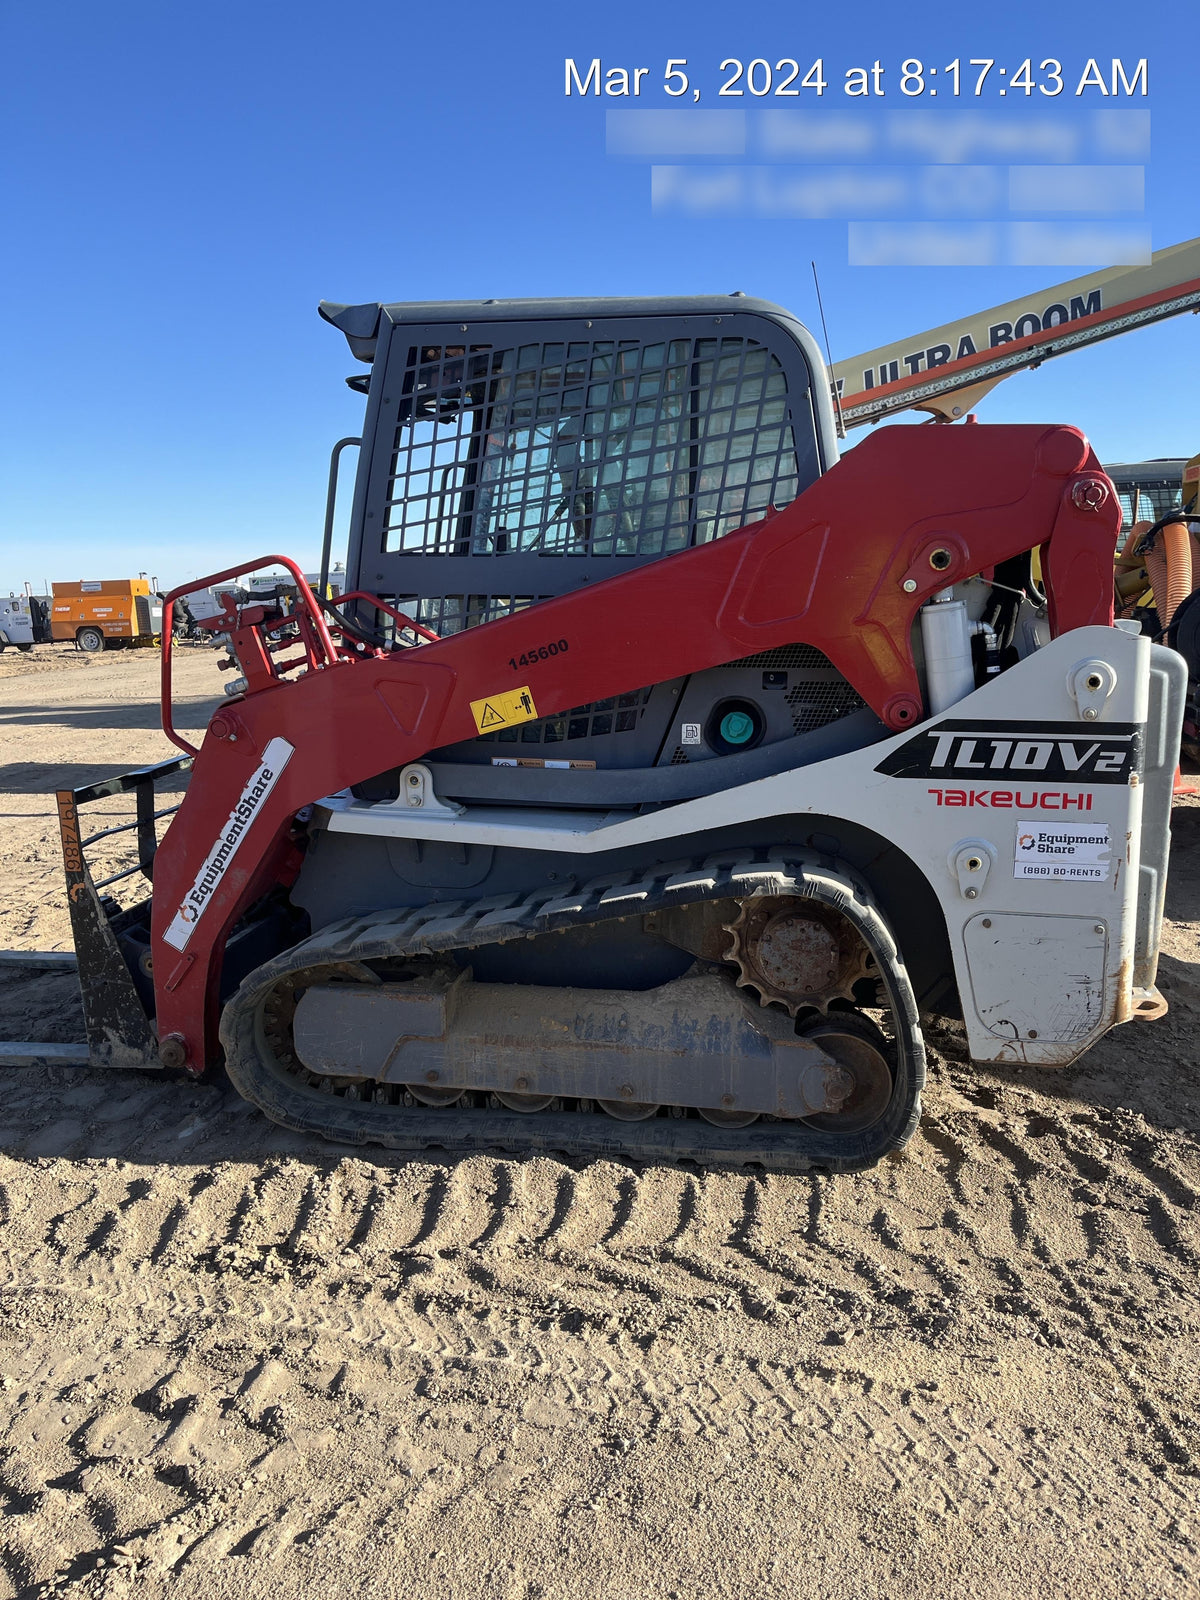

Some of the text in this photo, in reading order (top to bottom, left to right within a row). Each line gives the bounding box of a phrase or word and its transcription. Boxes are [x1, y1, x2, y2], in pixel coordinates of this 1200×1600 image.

[863, 288, 1101, 389] ULTRA BOOM
[508, 639, 569, 670] 145600
[59, 798, 81, 870] 197486
[189, 768, 274, 906] EquipmentShare
[1037, 843, 1075, 854] Share
[1038, 832, 1110, 845] Equipment
[1023, 866, 1050, 875] (888)
